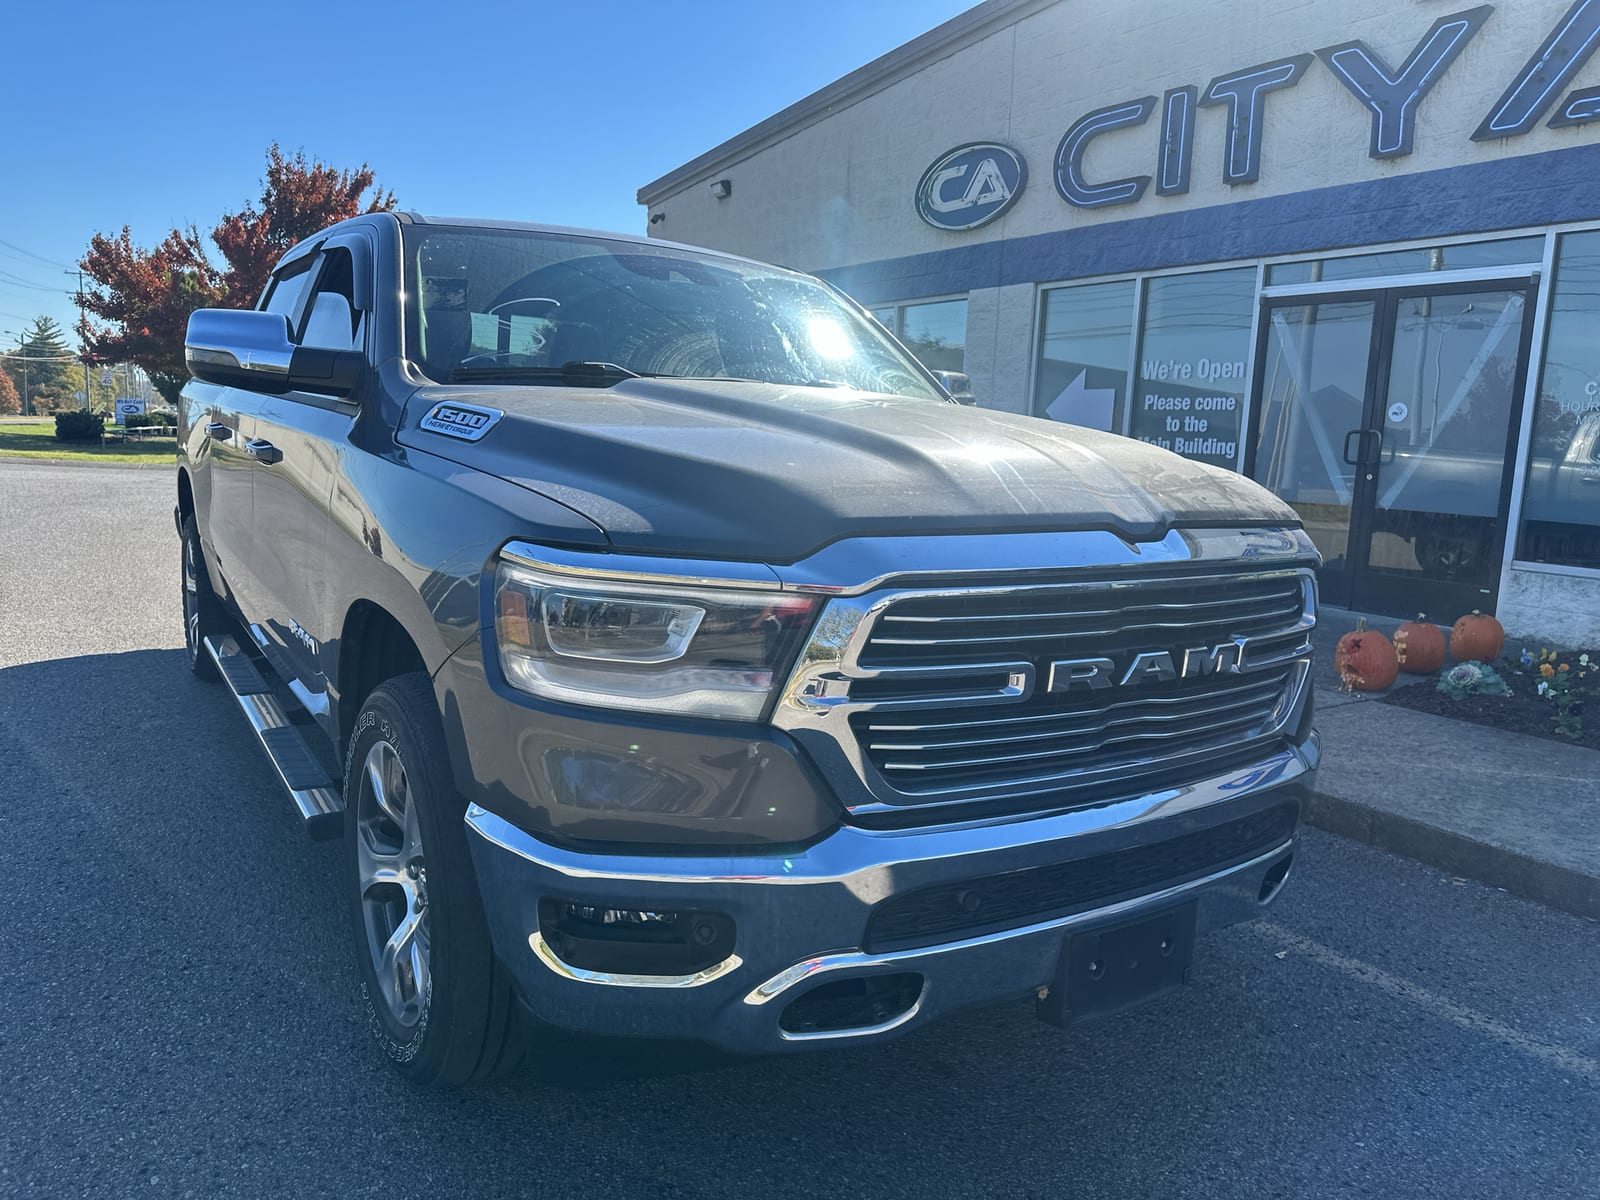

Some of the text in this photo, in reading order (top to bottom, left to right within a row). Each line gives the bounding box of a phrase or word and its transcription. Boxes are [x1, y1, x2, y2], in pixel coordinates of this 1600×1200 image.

[1053, 6, 1495, 209] CITY
[928, 158, 1011, 213] CA
[1143, 358, 1245, 383] We're Open
[1144, 394, 1236, 411] Please come
[438, 408, 488, 428] 1500
[1166, 416, 1208, 433] to the
[1175, 437, 1236, 459] Building
[1047, 642, 1242, 693] RAM
